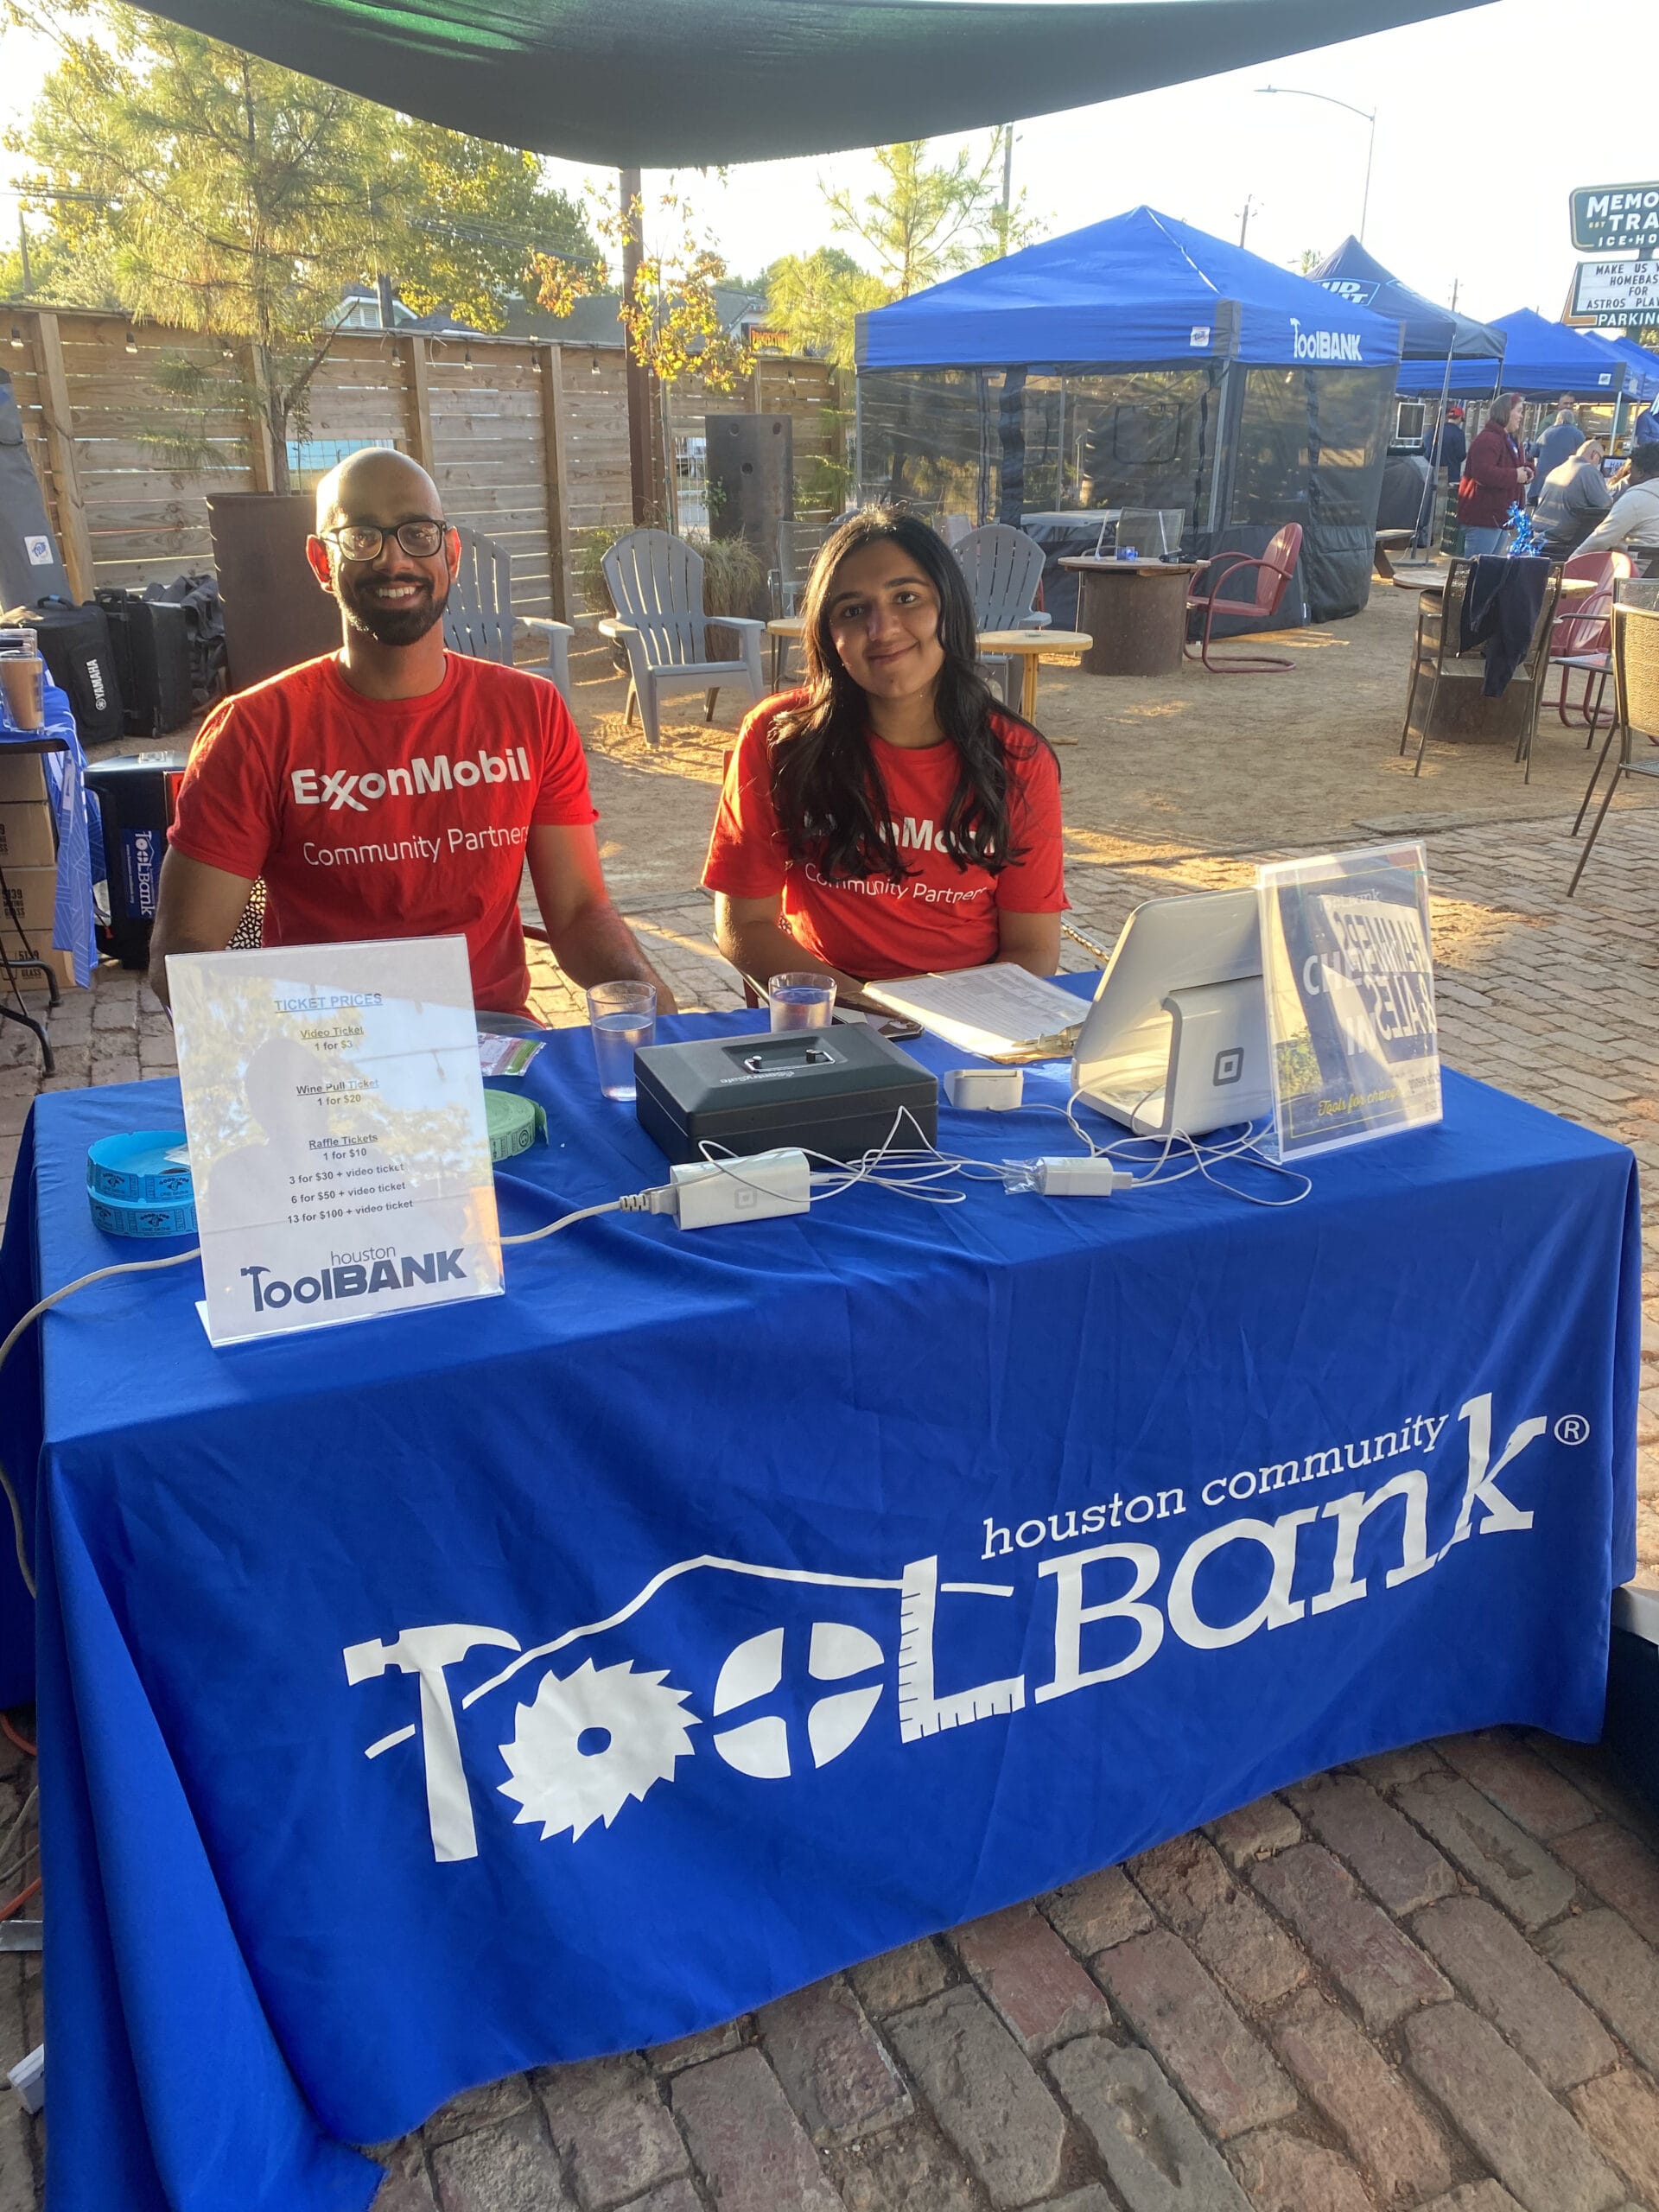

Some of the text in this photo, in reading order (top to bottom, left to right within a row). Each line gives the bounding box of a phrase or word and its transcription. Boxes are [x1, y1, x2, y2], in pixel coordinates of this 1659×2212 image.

[1596, 264, 1624, 275] MAKE
[1635, 264, 1648, 273] US
[1610, 274, 1659, 286] HOMEBAS
[1629, 286, 1648, 296] FOR
[1586, 298, 1626, 309] ASTROS
[86, 658, 105, 700] YAMAHA
[290, 747, 531, 812] ExxonMobil
[303, 835, 441, 865] Community
[274, 993, 383, 1011] TICKET PRICES
[301, 1026, 364, 1039] Video Ticket
[323, 1041, 338, 1051] for
[341, 1039, 353, 1049] $3
[296, 1079, 379, 1095] Wine Pull Ticket
[327, 1096, 340, 1105] for
[344, 1094, 361, 1103] $20
[308, 1134, 378, 1149] Raffle Tickets
[332, 1151, 346, 1160] for
[349, 1147, 367, 1158] $10
[289, 1176, 296, 1185] 3
[298, 1174, 313, 1183] for
[315, 1171, 334, 1182] $30
[346, 1166, 373, 1178] video
[376, 1163, 404, 1173] ticket
[291, 1195, 297, 1204] 6
[300, 1193, 315, 1203] for
[317, 1190, 335, 1201] $50
[347, 1185, 375, 1197] video
[378, 1181, 405, 1192] ticket
[287, 1215, 300, 1224] 13
[302, 1213, 317, 1223] for
[320, 1208, 343, 1219] $100
[355, 1204, 383, 1215] video
[385, 1199, 414, 1211] ticket
[330, 1246, 396, 1266] houston
[240, 1248, 467, 1313] ToolBANK
[980, 1414, 1449, 1561] houston community
